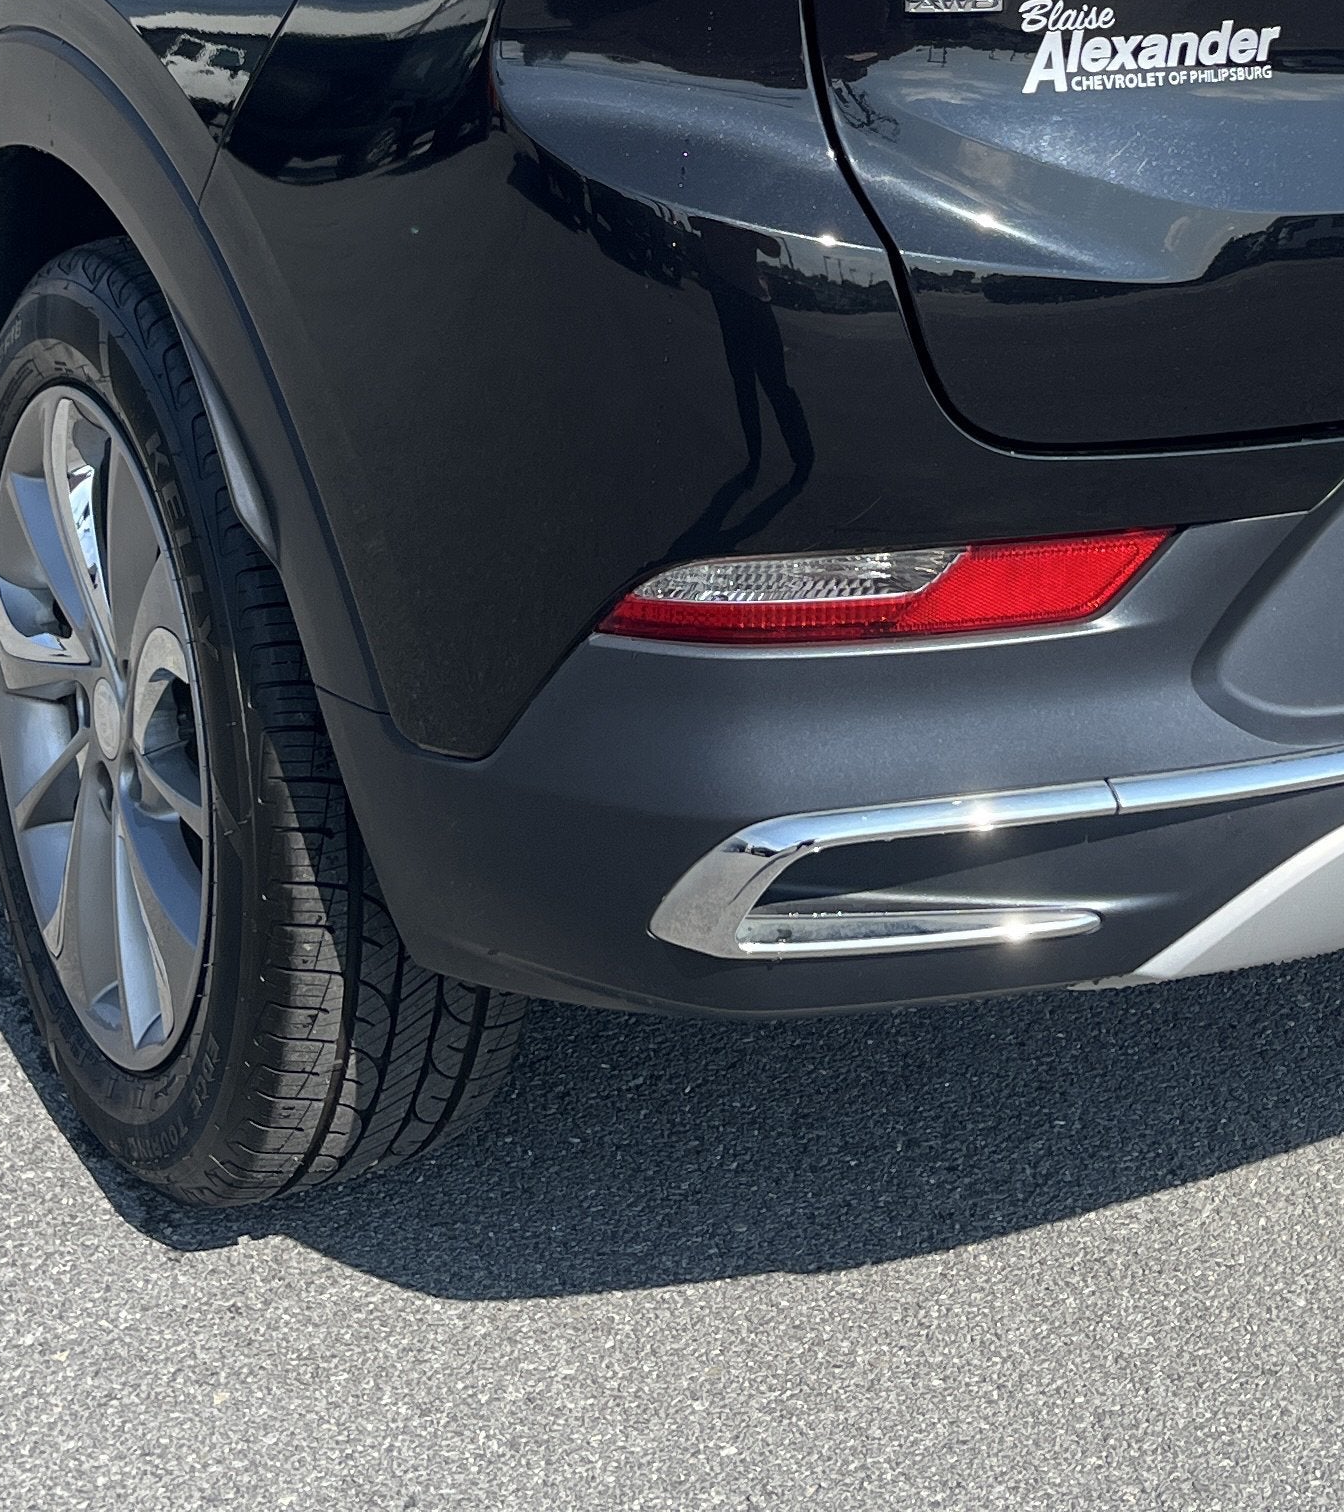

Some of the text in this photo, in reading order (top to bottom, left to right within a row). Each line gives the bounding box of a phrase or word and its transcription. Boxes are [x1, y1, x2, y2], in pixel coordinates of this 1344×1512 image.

[1021, 19, 1282, 94] Alexander
[1071, 64, 1273, 92] CHEVROLET OF PHILIPSBURG
[145, 431, 220, 663] KELLY
